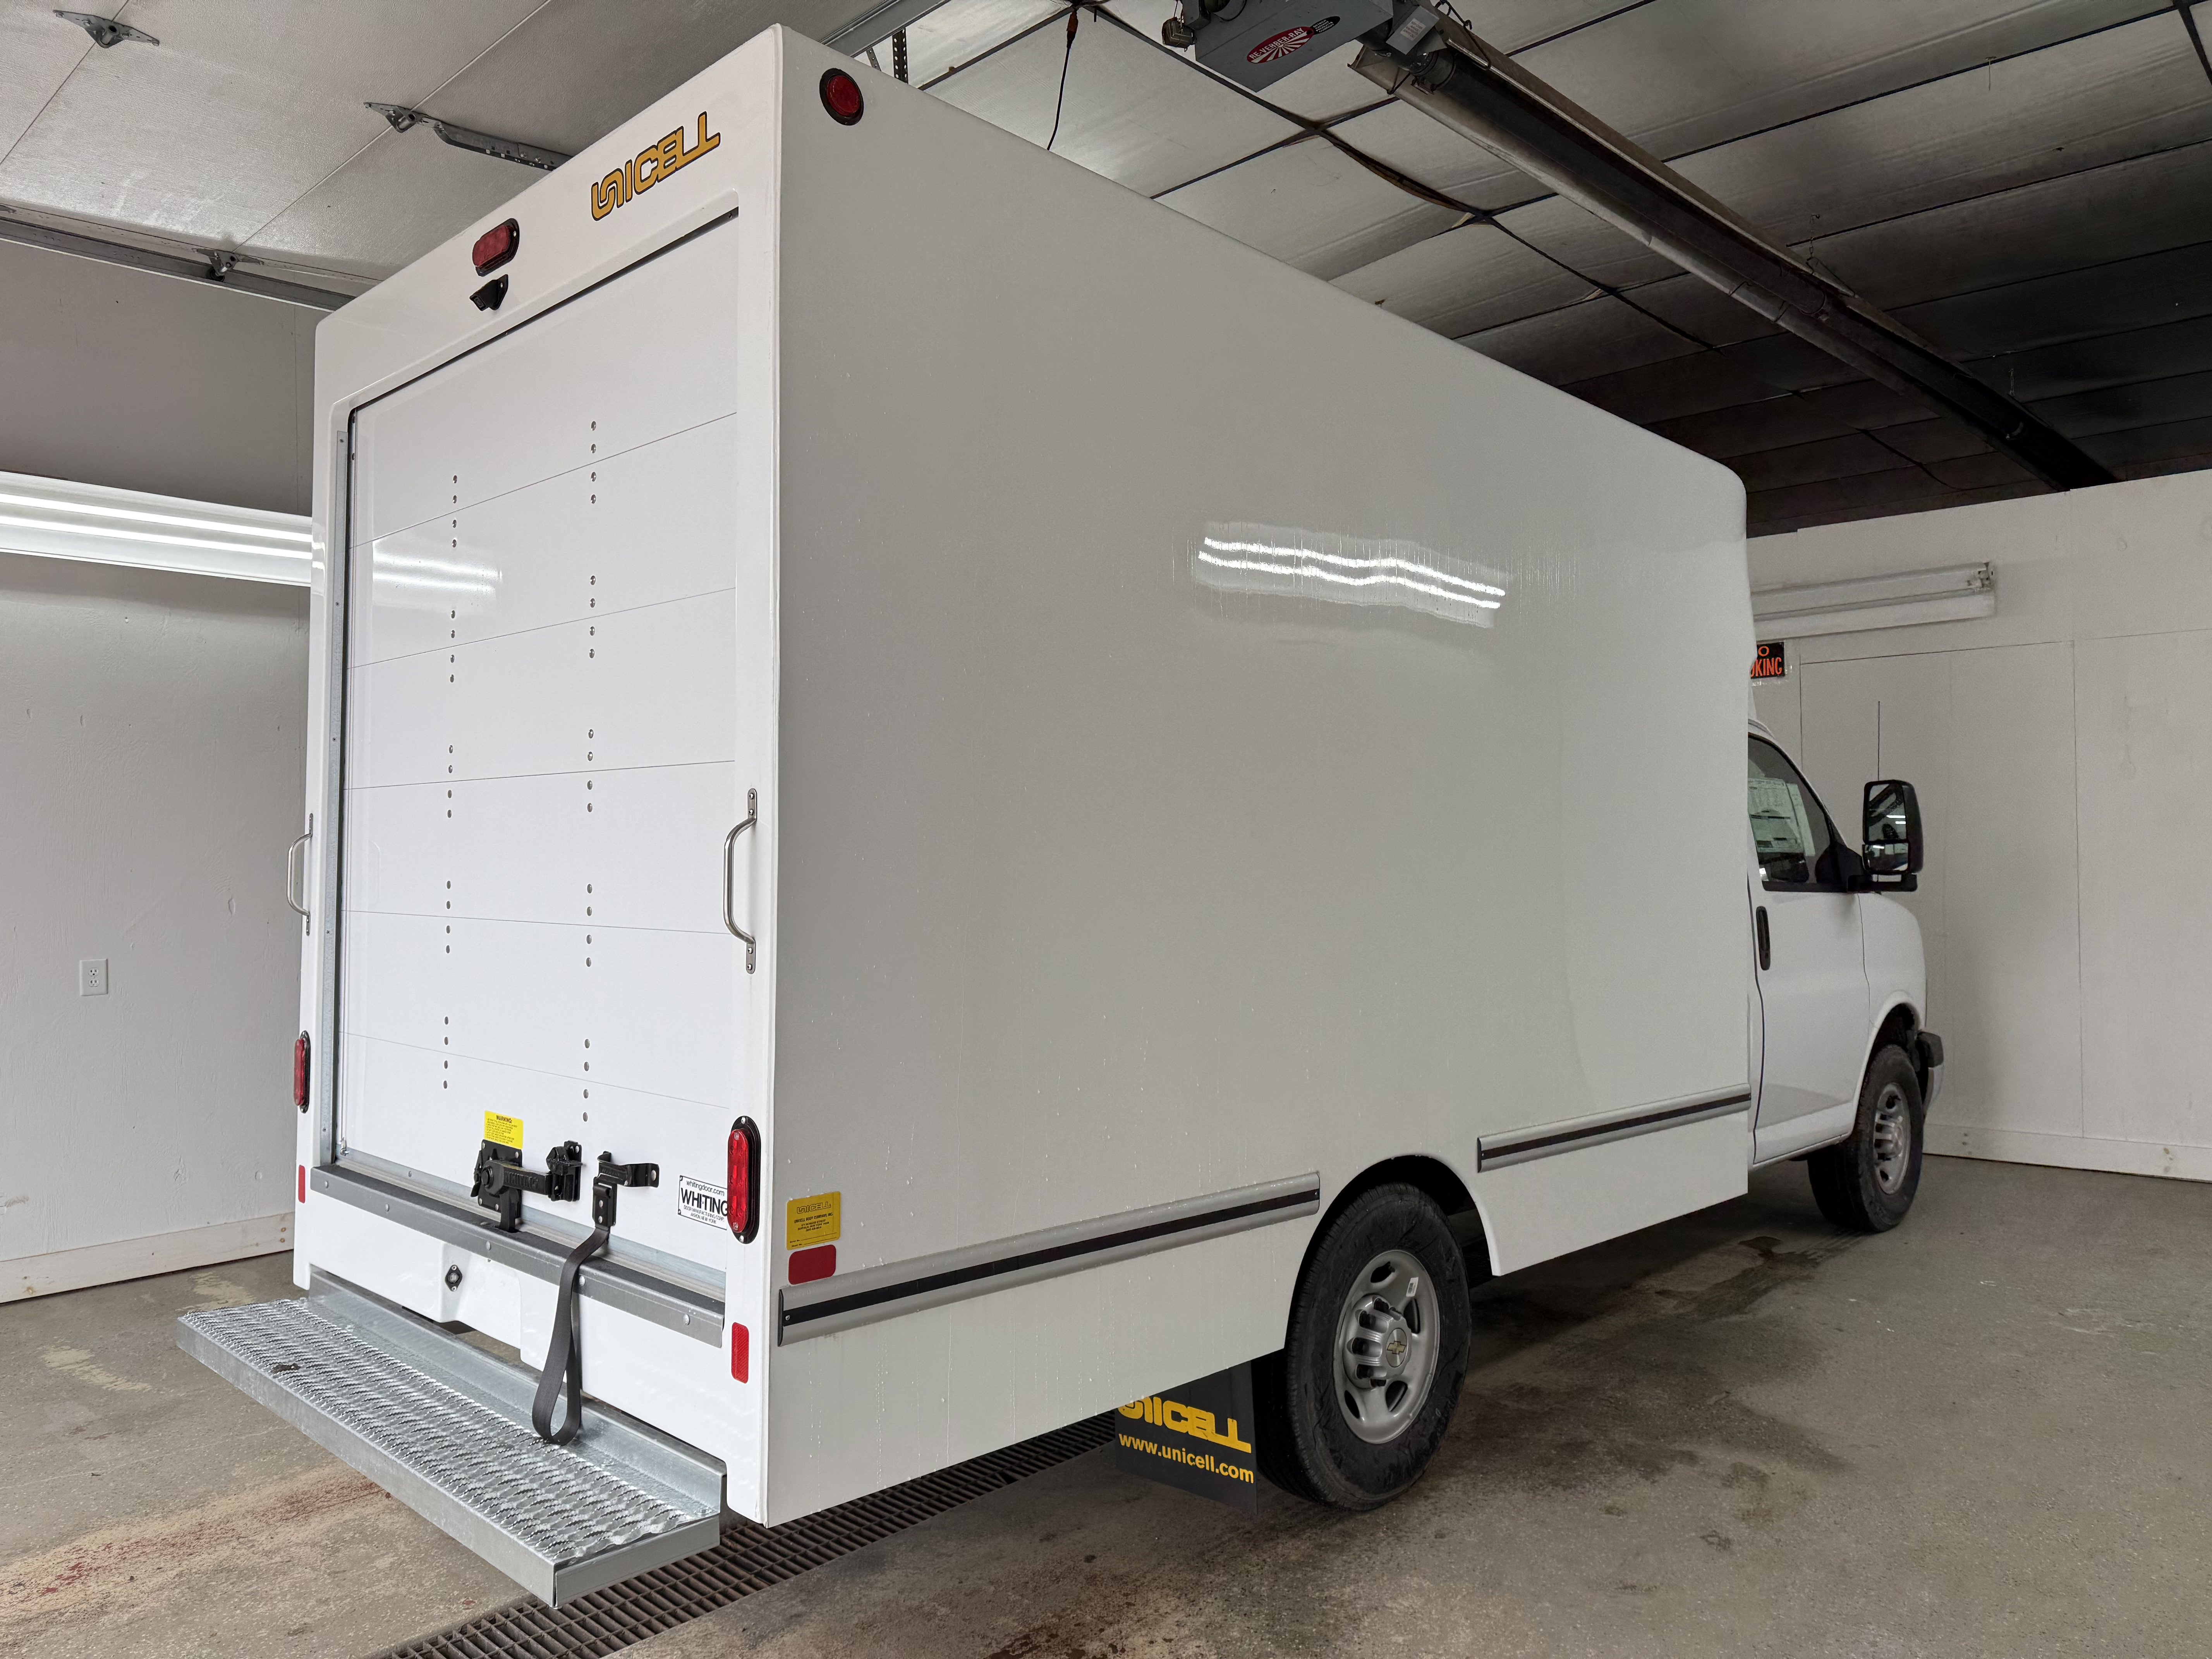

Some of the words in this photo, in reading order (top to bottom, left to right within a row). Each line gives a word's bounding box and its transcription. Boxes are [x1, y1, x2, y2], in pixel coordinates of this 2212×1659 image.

[1249, 27, 1304, 59] RE-VERBER-RAY
[591, 111, 721, 221] UNICELL
[1758, 646, 1769, 657] O
[681, 1187, 728, 1216] WHITING
[686, 1180, 725, 1196] whitingdoor.com
[797, 1202, 831, 1214] UNICELL
[1118, 1433, 1254, 1484] www.unicell.com
